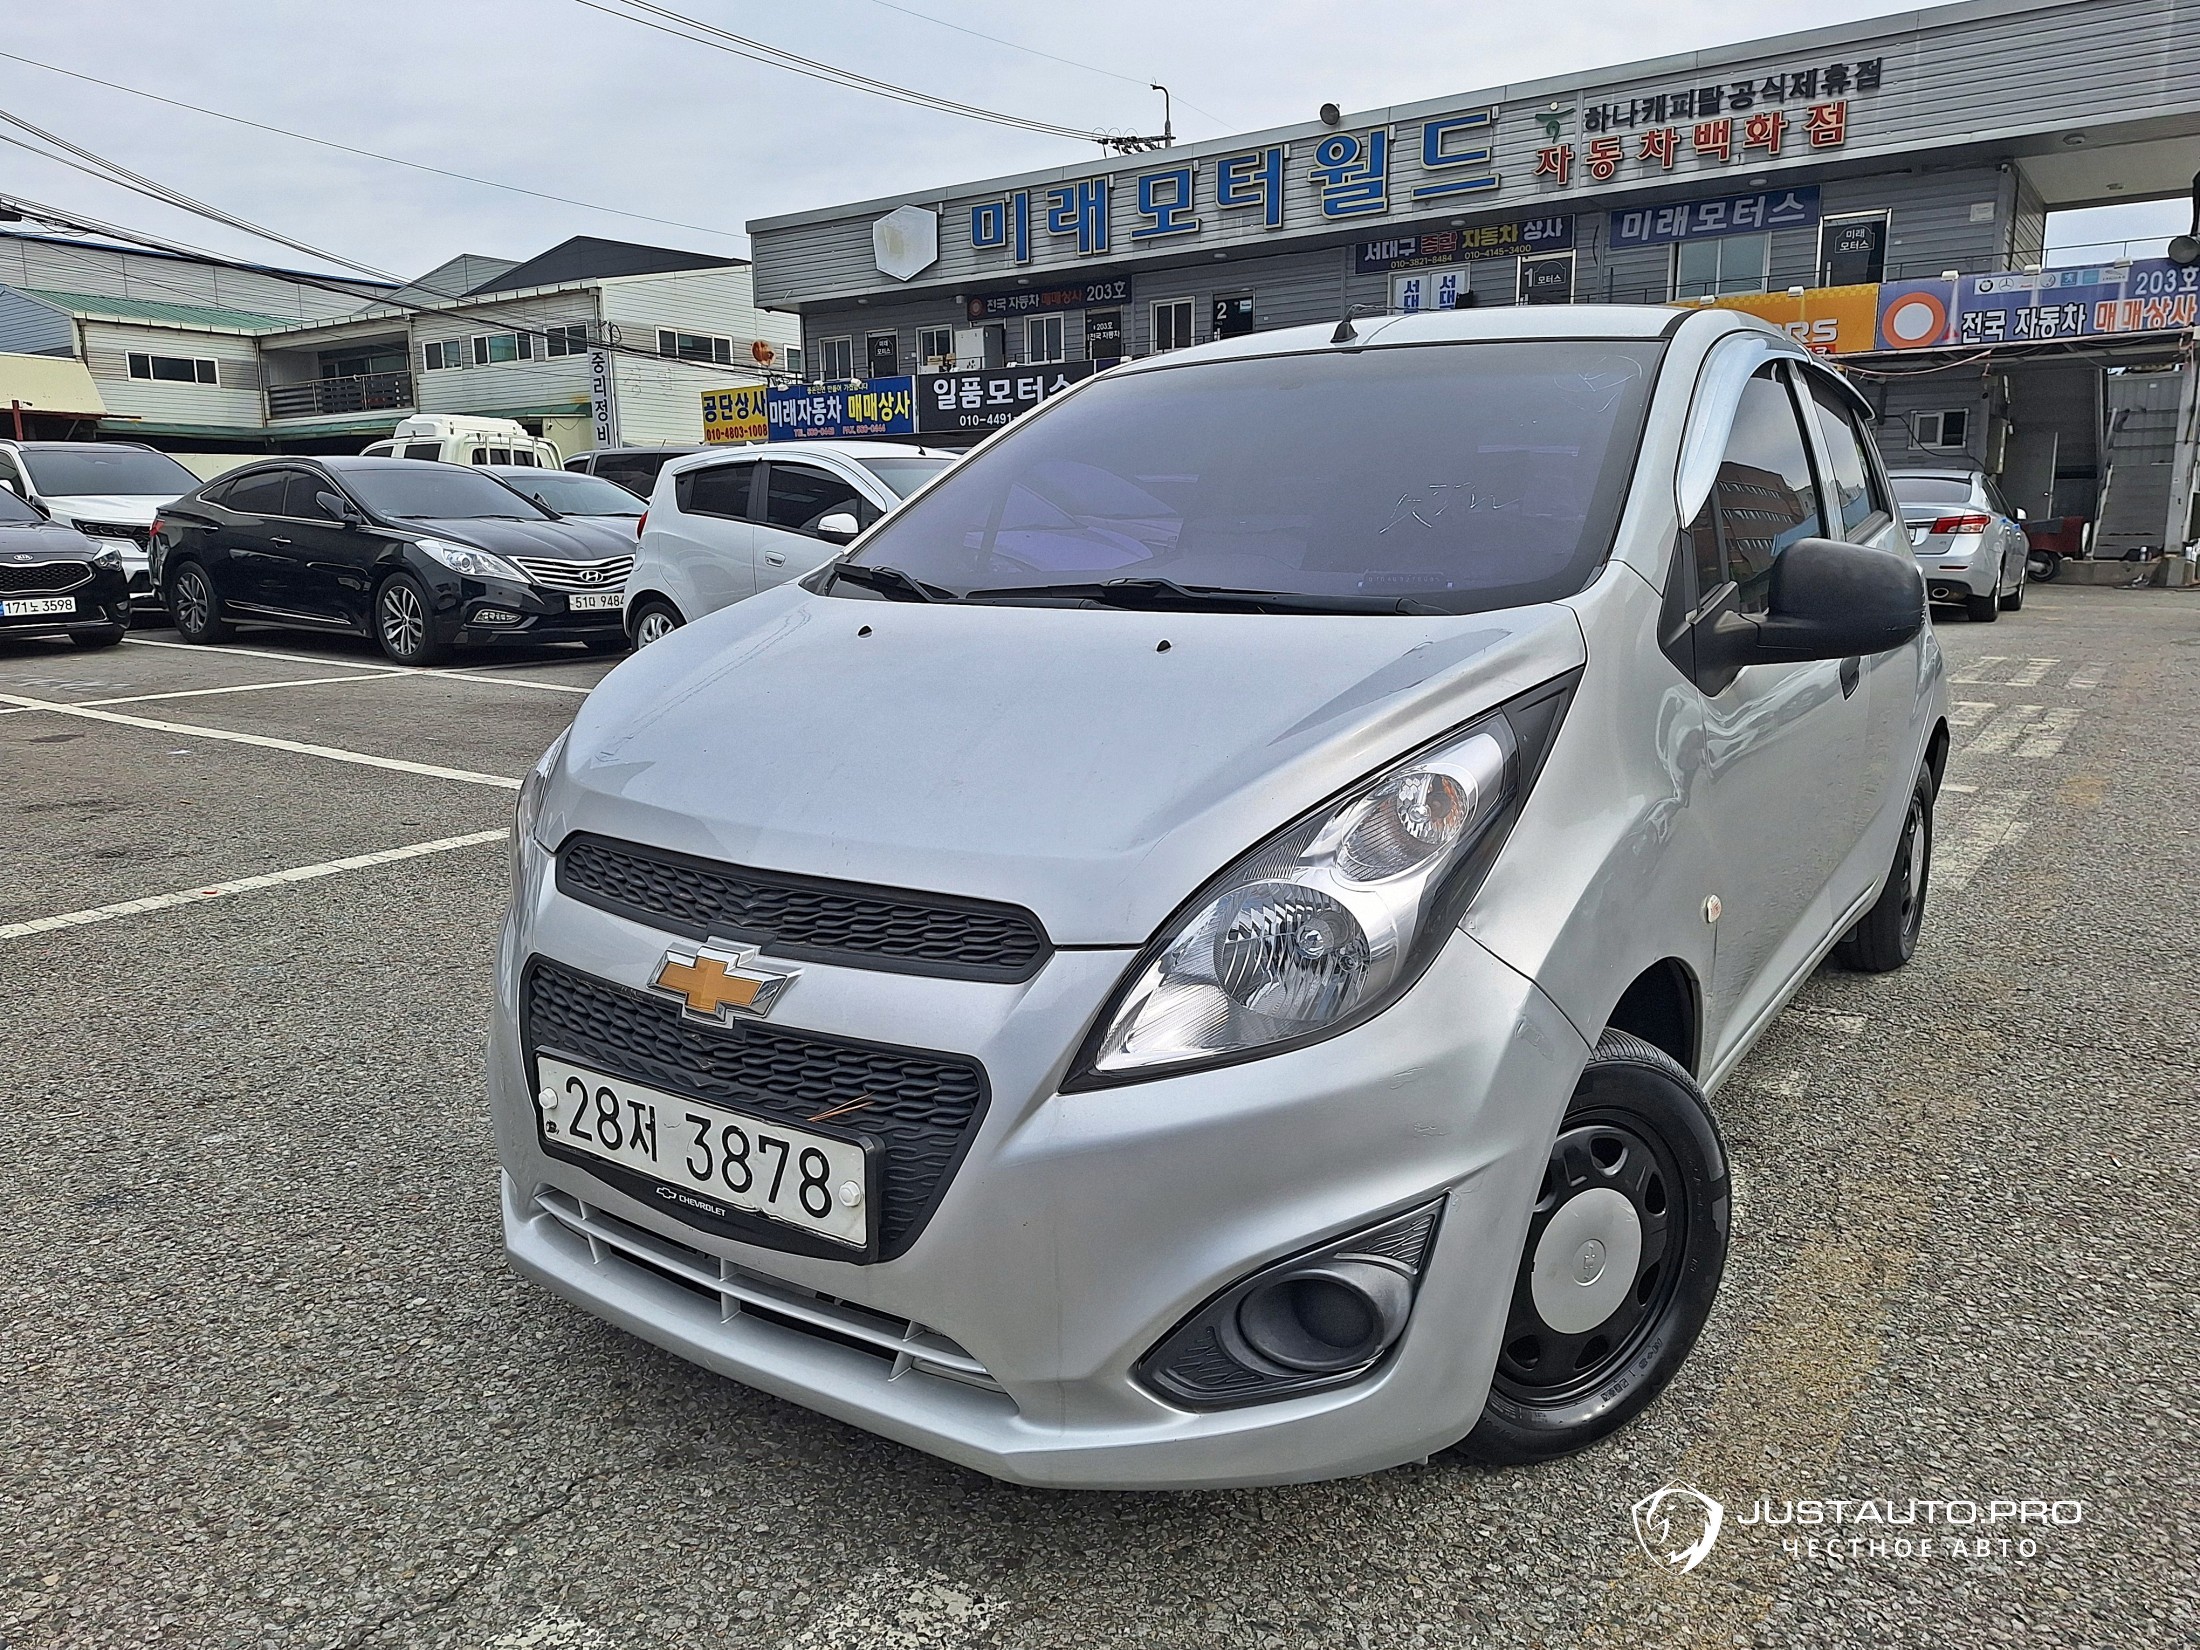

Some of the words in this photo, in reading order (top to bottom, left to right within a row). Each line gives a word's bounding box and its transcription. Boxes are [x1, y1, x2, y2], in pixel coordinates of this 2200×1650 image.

[1582, 57, 1883, 133] 하나캐피탈공식제휴점
[1620, 192, 1806, 241] 미래모터스
[1364, 237, 1416, 262] 서대구
[1420, 232, 1458, 254] 종합
[1462, 223, 1519, 249] 자동차
[1523, 217, 1563, 241] 상사
[1840, 240, 1869, 250] 모터스
[1846, 229, 1865, 239] 미래
[1390, 254, 1453, 269] 010-3821-8484
[1464, 244, 1532, 260] 010-4145-3400
[1524, 268, 1533, 288] 1
[1537, 274, 1562, 284] 모터스
[2134, 265, 2199, 295] 203호
[986, 299, 1006, 313] 전국
[1008, 293, 1039, 310] 자동차
[1086, 281, 1126, 301] 203호
[1217, 302, 1226, 319] 2
[1774, 318, 1838, 343] RS
[1961, 310, 2006, 343] 전국
[2014, 302, 2088, 340] 자동차
[2093, 294, 2197, 333] 매매상사
[591, 352, 611, 445] 중리정비
[703, 390, 768, 423] 공단상사
[769, 395, 842, 427] 미래자동차
[847, 390, 911, 423] 매매상사
[706, 425, 768, 441] 010-4803-1008
[5, 602, 39, 614] 171노
[42, 599, 73, 612] 3598
[565, 1076, 658, 1162] 28저
[686, 1112, 832, 1219] 3878
[678, 1194, 727, 1217] CHEVROLET
